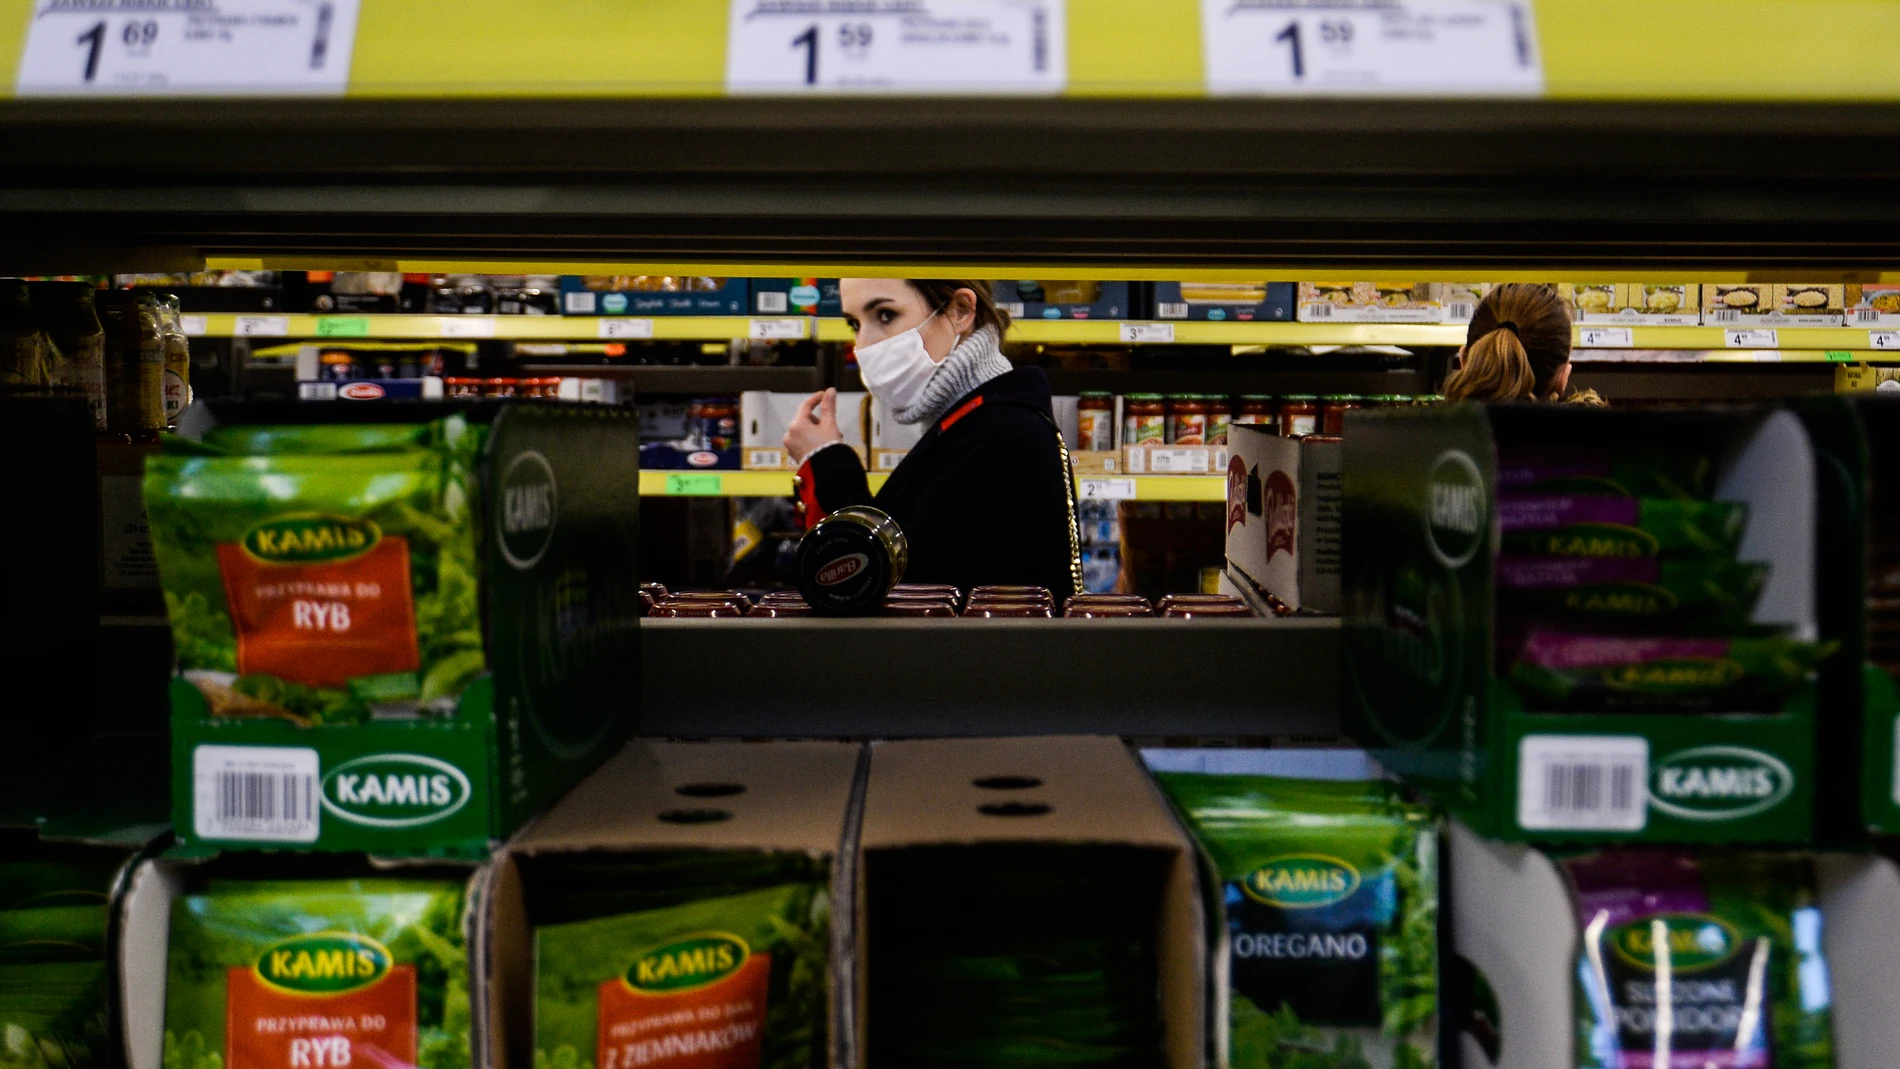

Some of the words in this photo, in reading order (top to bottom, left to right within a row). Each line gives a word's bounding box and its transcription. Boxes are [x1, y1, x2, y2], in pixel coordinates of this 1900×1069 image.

[77, 20, 107, 82] 1
[122, 20, 159, 46] 69
[791, 24, 819, 85] 1
[1275, 19, 1304, 78] 1
[1130, 328, 1137, 340] 3
[1587, 332, 1594, 344] 4
[1734, 334, 1741, 346] 4
[1876, 335, 1884, 347] 4
[1087, 484, 1095, 496] 2
[256, 526, 366, 556] KAMIS
[820, 559, 857, 582] Barilla
[293, 600, 351, 632] RYB
[336, 773, 452, 806] KAMIS
[1658, 767, 1774, 798] KAMIS
[1256, 867, 1347, 892] KAMIS
[1234, 933, 1368, 960] OREGANO
[271, 949, 376, 979] KAMIS
[636, 944, 735, 984] KAMIS
[256, 1015, 357, 1033] PRZYPRAWA
[360, 1014, 386, 1031] DO
[290, 1036, 352, 1067] RYB
[621, 1020, 760, 1069] ZIEMNIAKÓW
